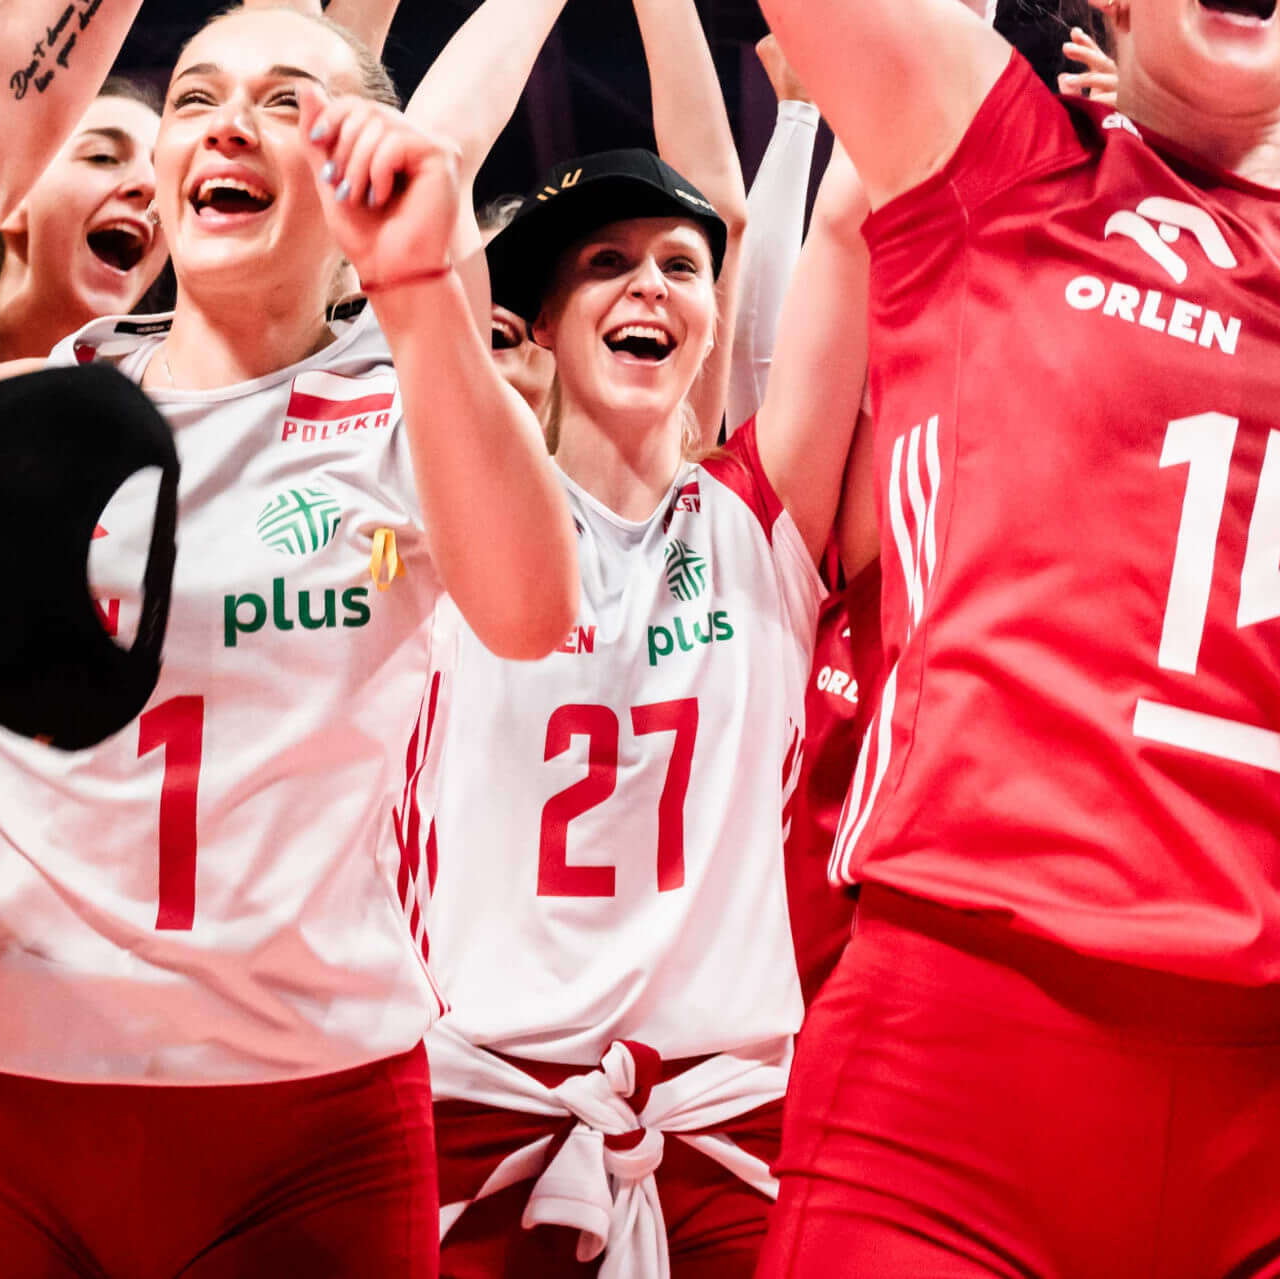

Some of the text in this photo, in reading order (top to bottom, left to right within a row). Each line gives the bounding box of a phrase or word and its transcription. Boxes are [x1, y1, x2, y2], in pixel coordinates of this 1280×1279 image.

[1065, 275, 1243, 357] ORLEN
[281, 412, 391, 443] POLSKA
[224, 577, 372, 649] plus
[648, 610, 735, 667] plus
[817, 664, 859, 704] ORL
[136, 694, 205, 932] 1
[536, 697, 699, 898] 27
